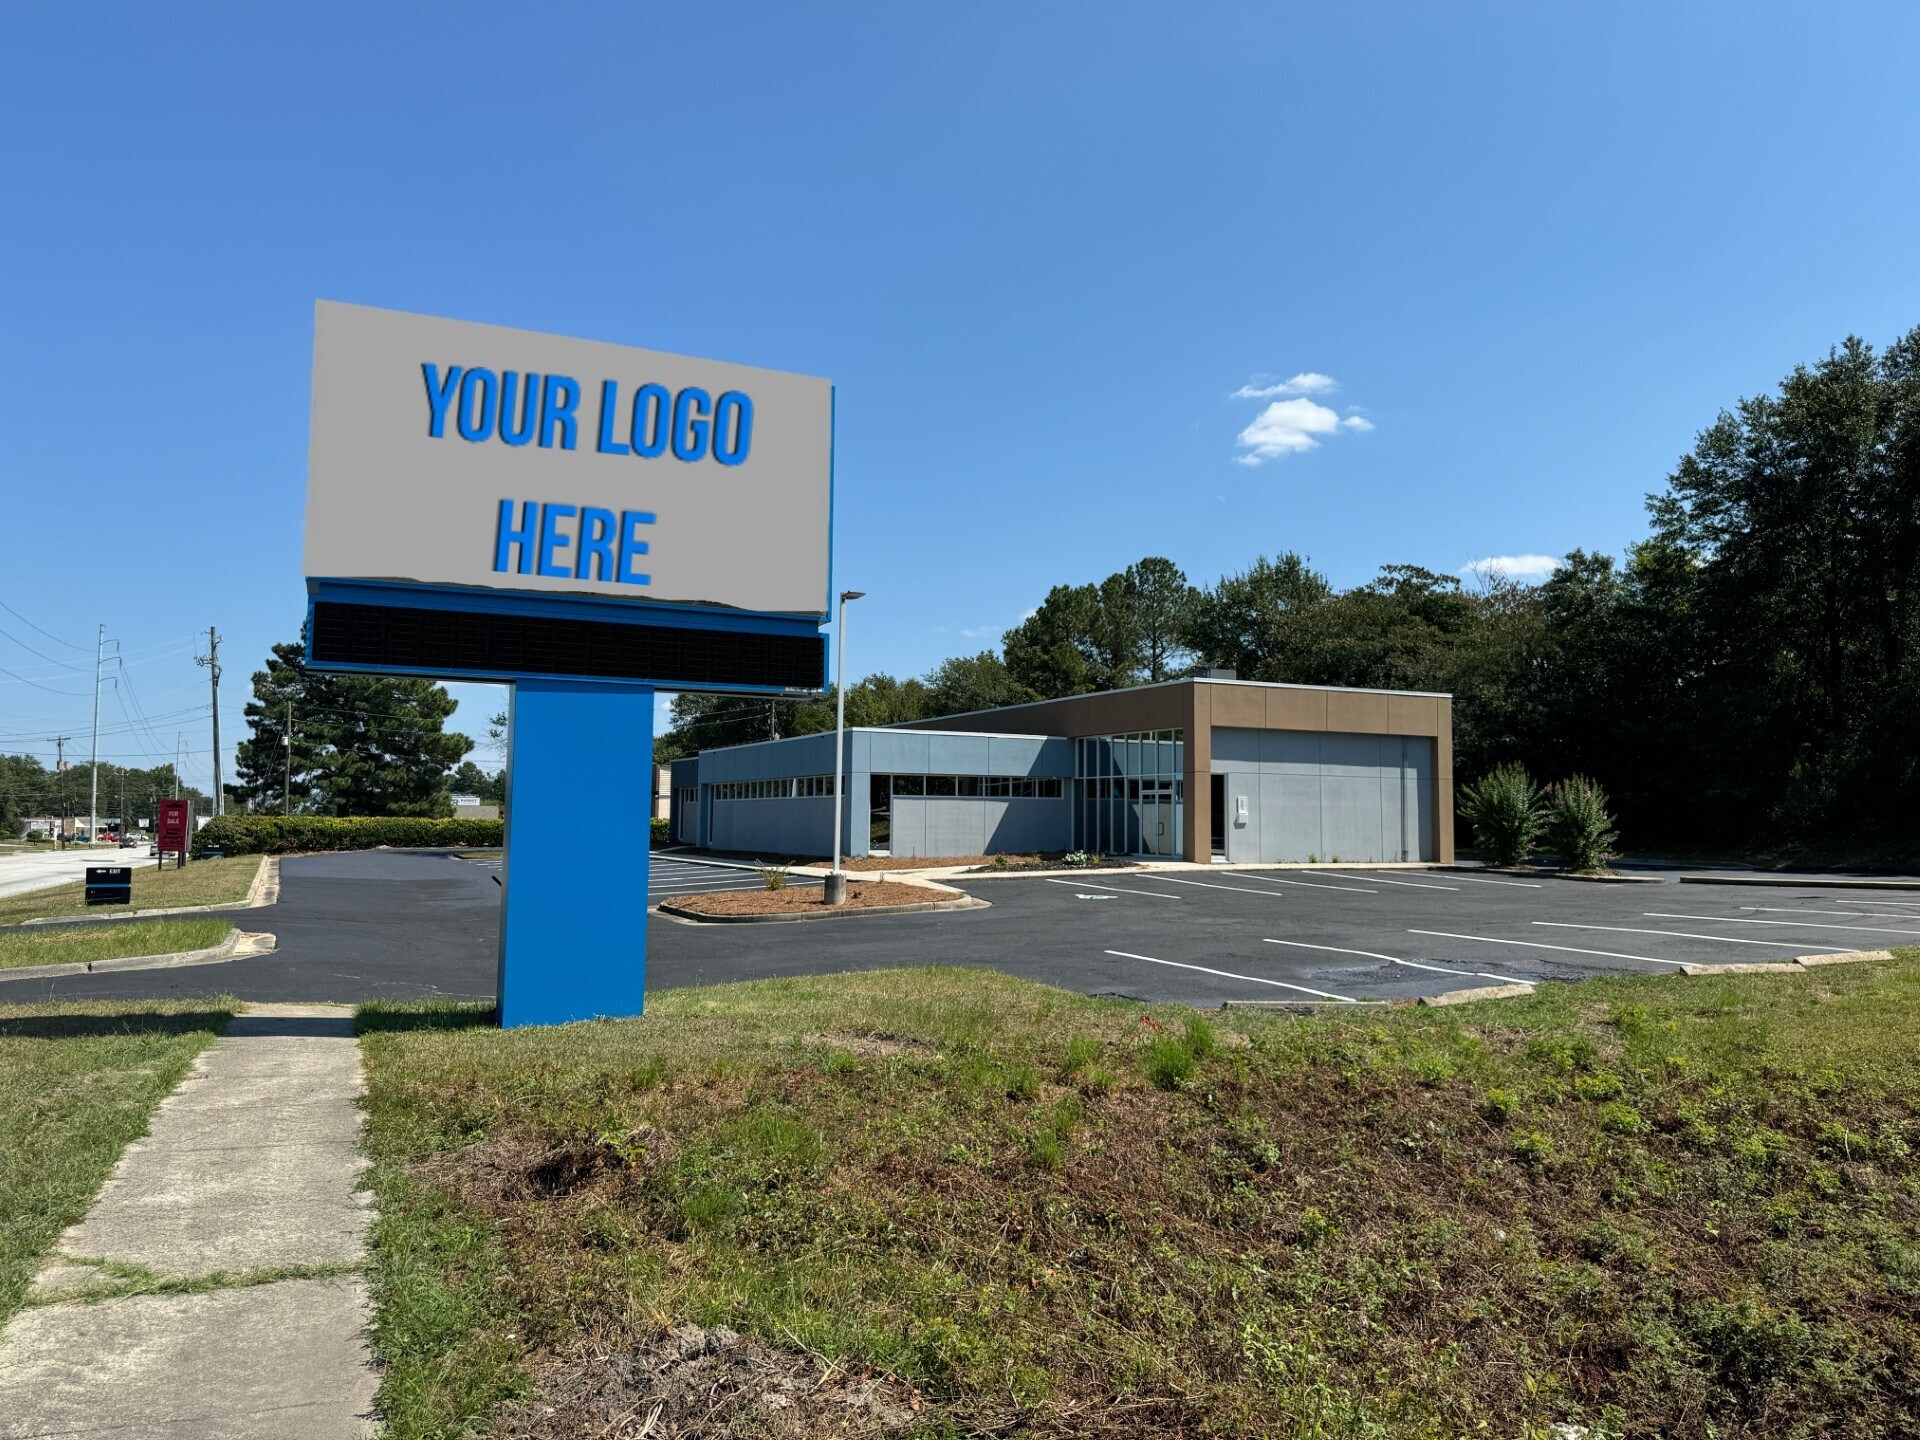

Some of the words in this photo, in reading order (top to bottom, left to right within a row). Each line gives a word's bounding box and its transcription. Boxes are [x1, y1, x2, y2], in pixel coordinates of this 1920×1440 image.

[421, 363, 581, 450] YOUR
[596, 379, 754, 467] LOGO
[492, 498, 657, 586] HERE
